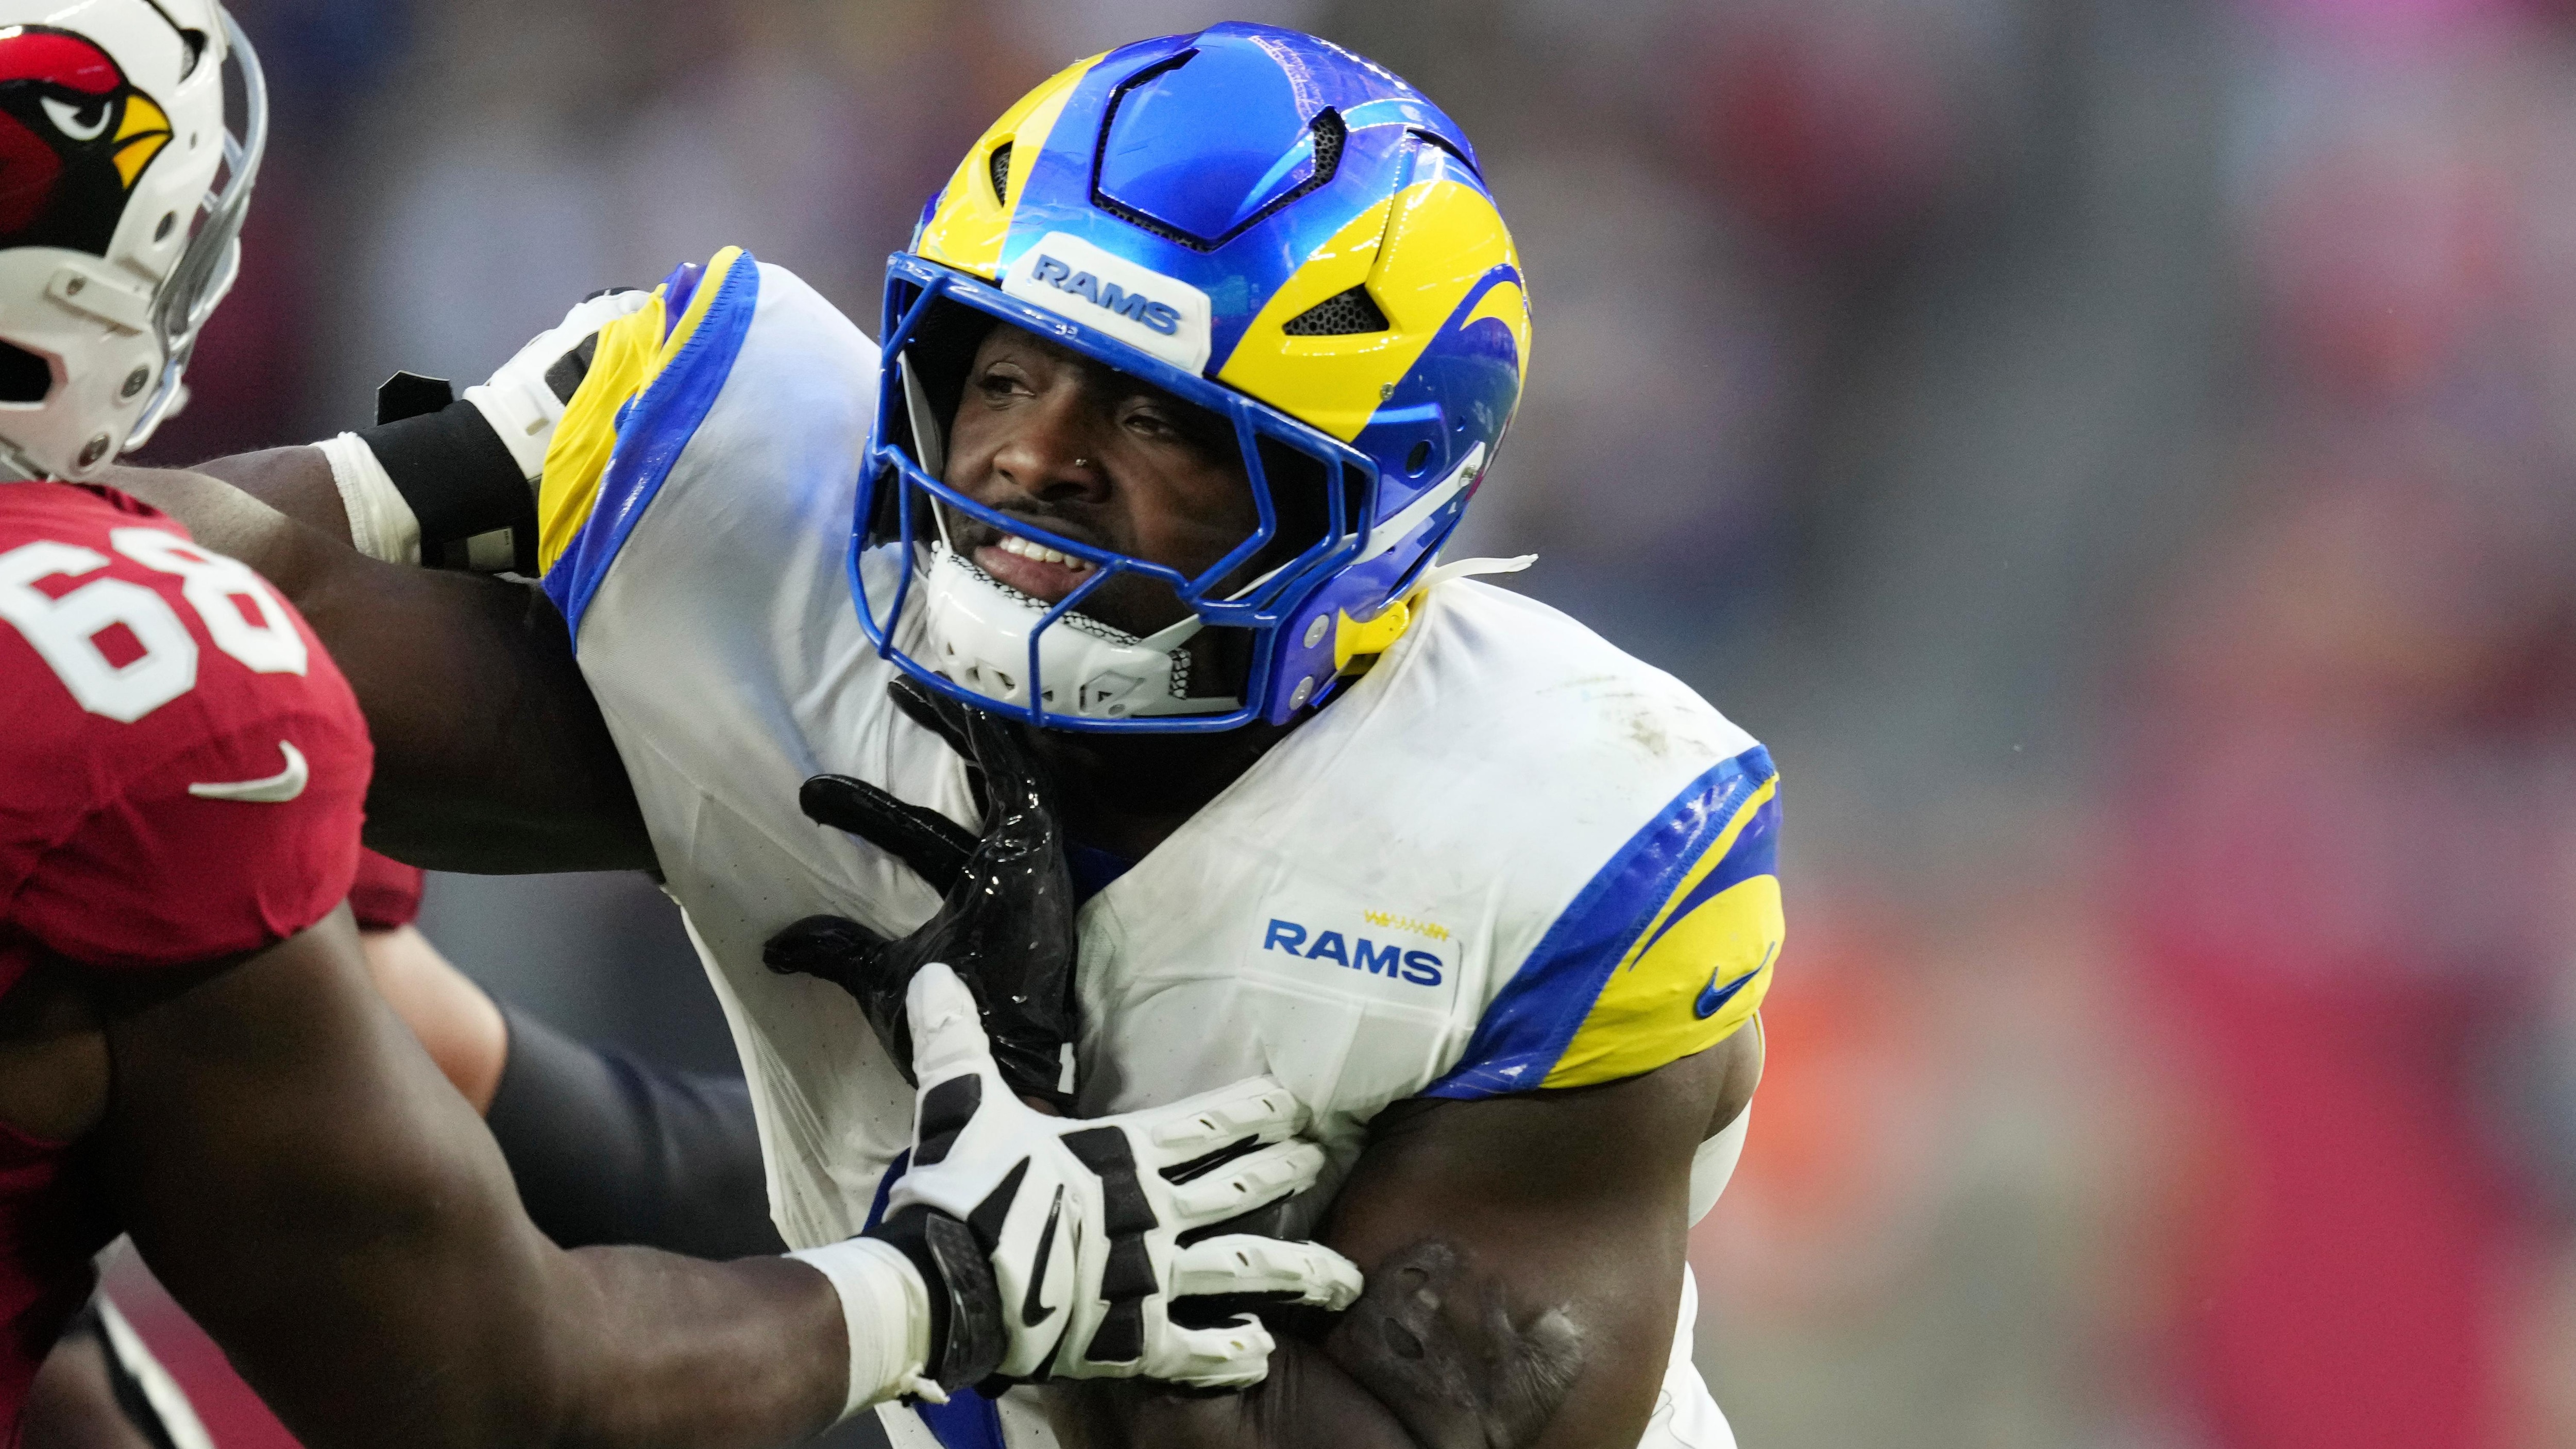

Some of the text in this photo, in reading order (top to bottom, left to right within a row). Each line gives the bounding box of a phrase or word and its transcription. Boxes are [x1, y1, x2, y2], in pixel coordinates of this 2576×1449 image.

[1032, 254, 1181, 335] RAMS
[0, 527, 308, 723] 68
[1263, 918, 1444, 986] RAMS
